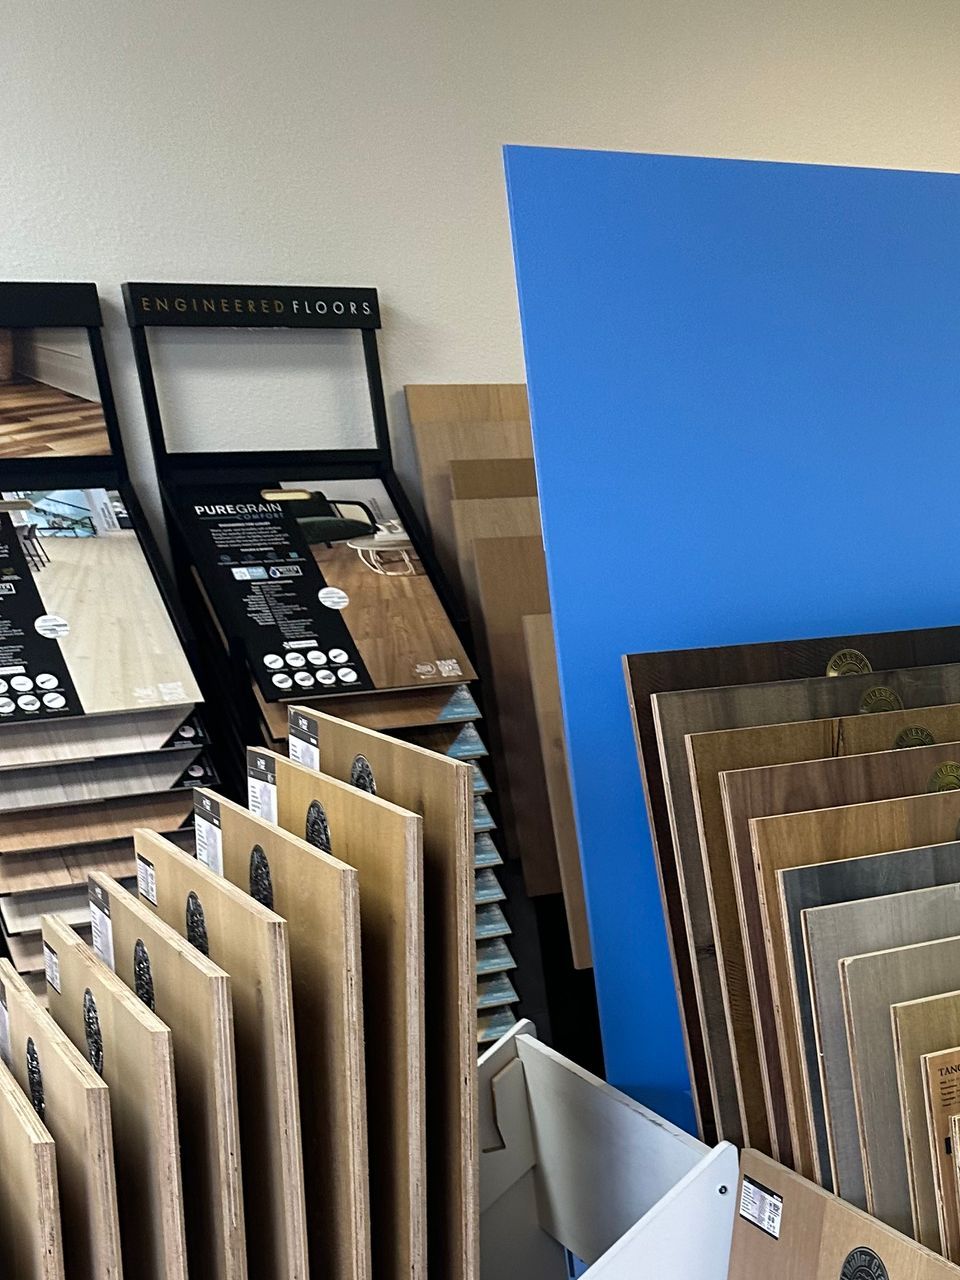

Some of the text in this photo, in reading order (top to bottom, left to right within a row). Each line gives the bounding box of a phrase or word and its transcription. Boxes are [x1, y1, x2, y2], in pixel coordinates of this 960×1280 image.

[141, 297, 372, 315] ENGINEERED FLOORS
[194, 503, 283, 515] PUREGRAIN
